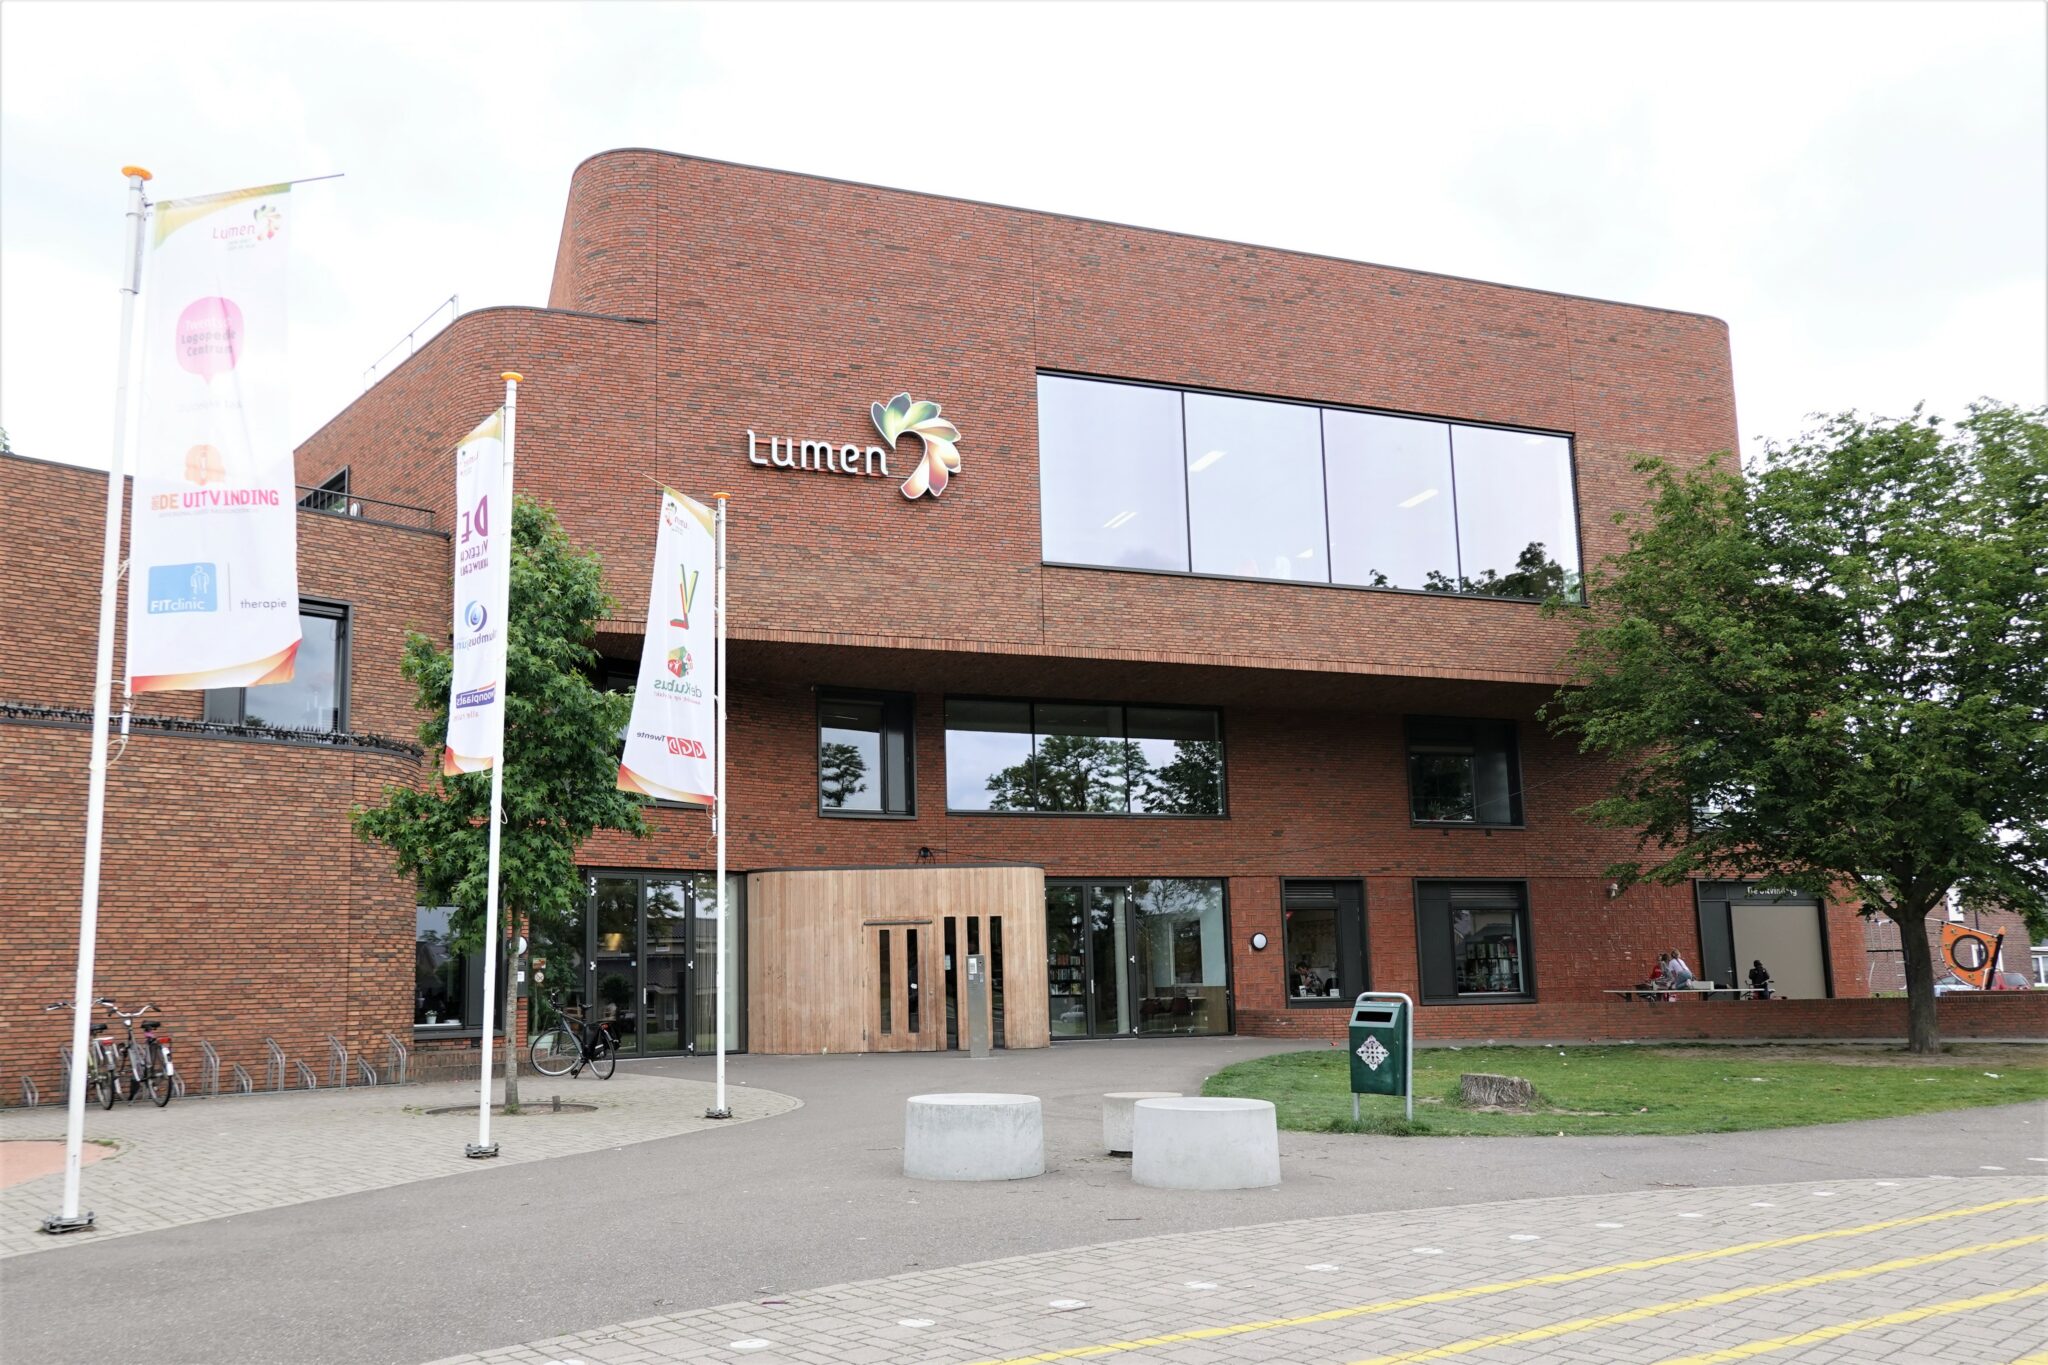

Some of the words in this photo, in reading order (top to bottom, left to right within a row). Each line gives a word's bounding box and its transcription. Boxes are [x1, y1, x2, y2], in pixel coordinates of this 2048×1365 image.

[212, 224, 256, 240] Lumen
[747, 428, 889, 476] Lumen
[160, 493, 179, 510] DE
[183, 488, 280, 508] UITVINDING
[151, 597, 206, 612] FITclinic
[240, 599, 287, 611] therapie
